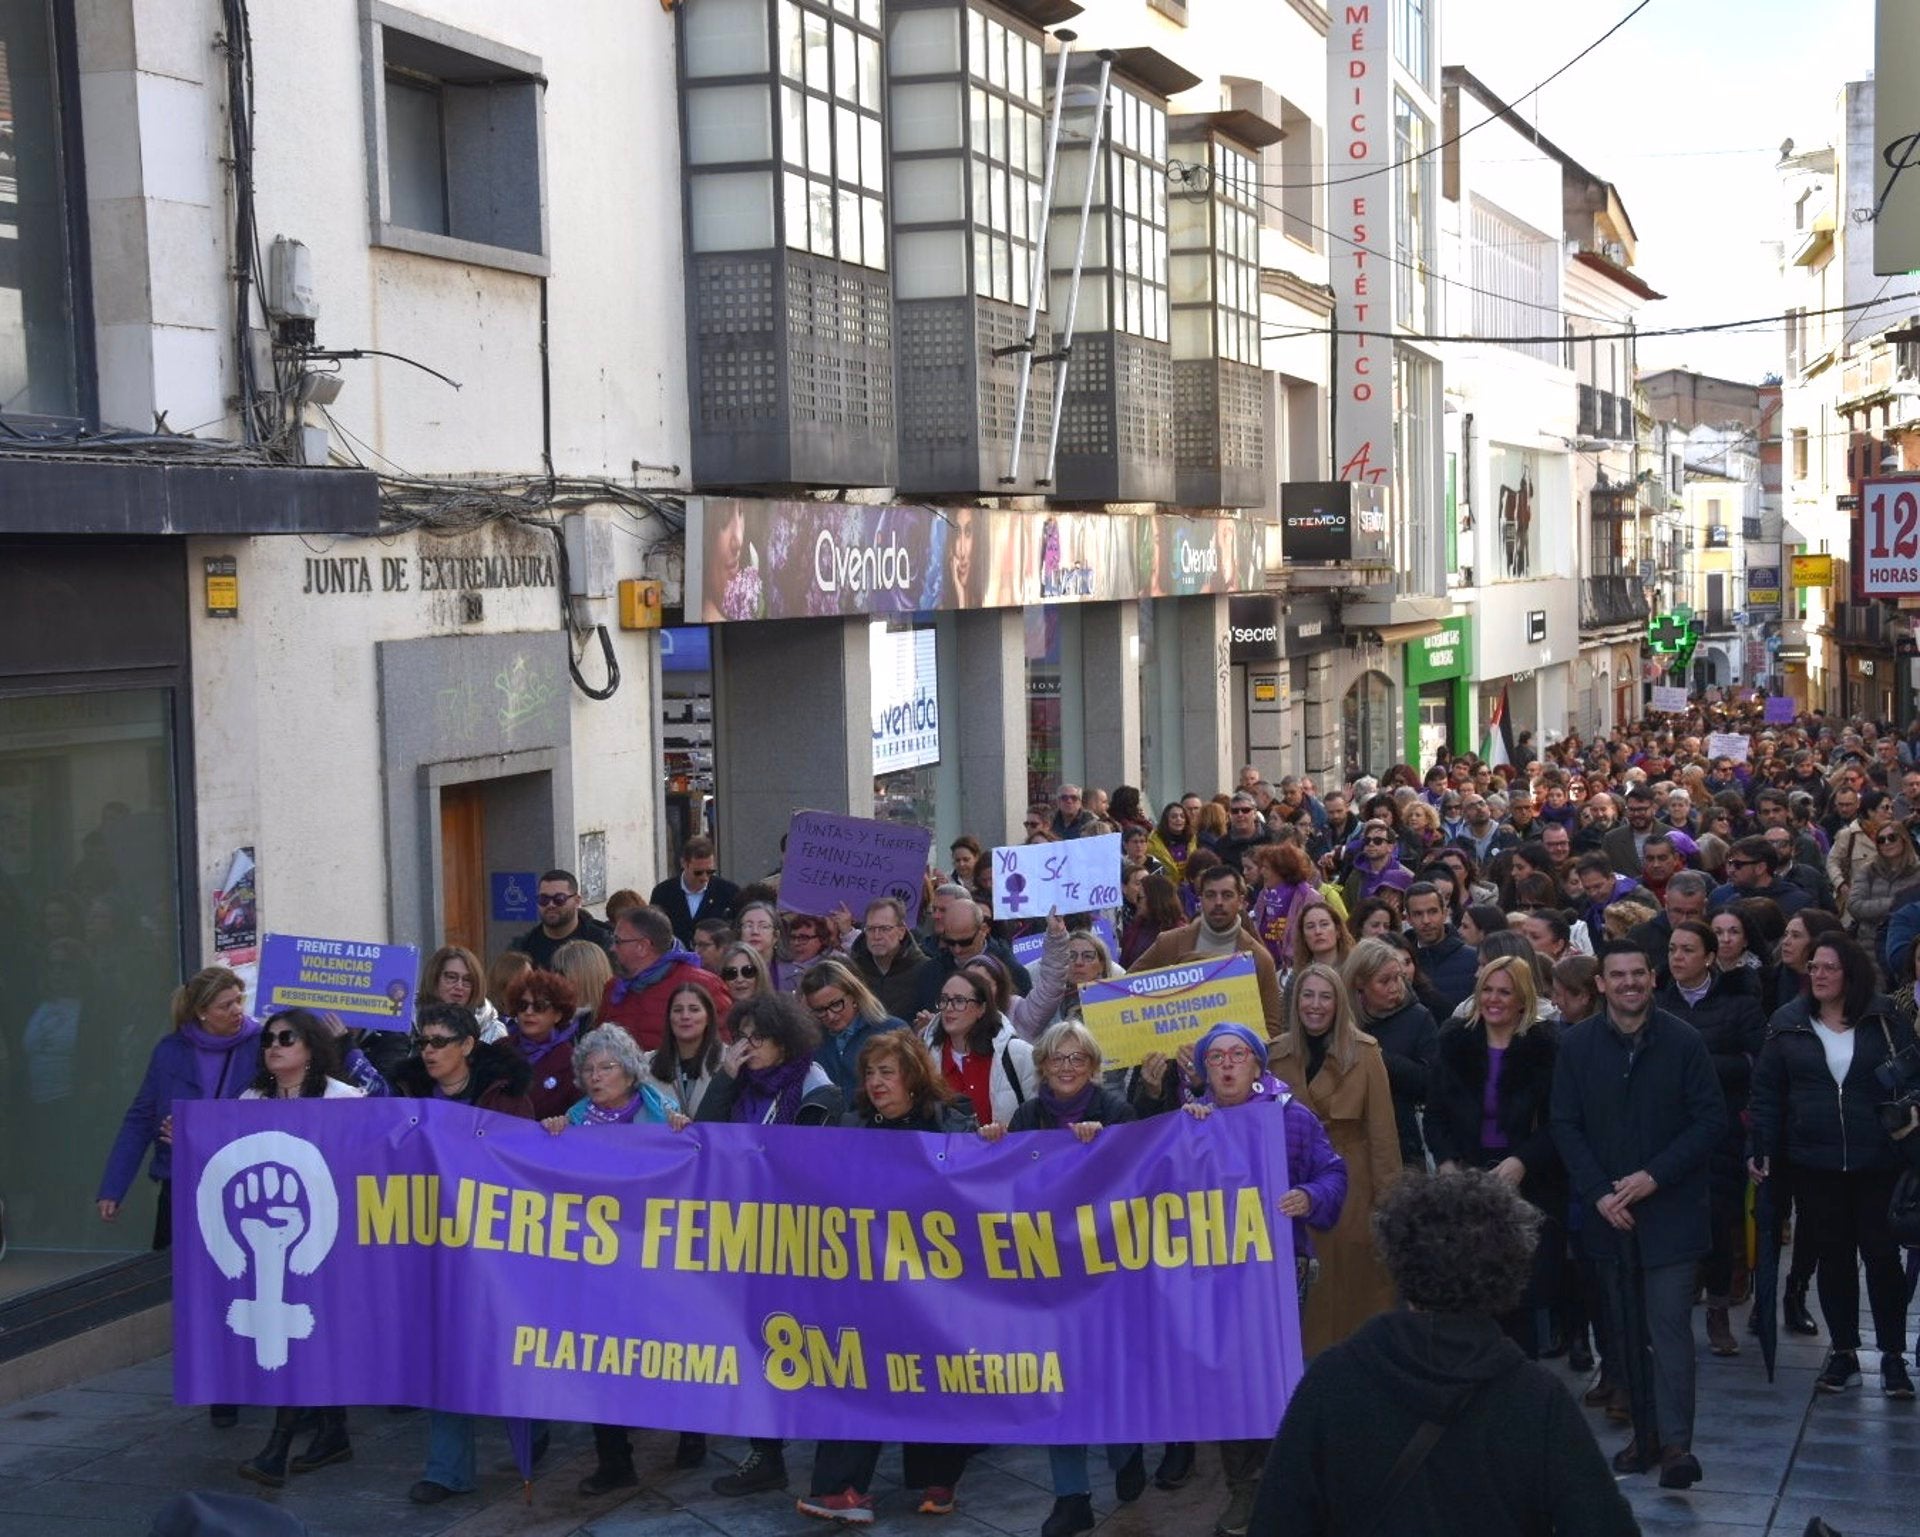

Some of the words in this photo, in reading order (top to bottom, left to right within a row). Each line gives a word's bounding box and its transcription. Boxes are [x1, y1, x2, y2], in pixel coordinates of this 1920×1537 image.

[1345, 5, 1369, 160] MÉDICO
[1352, 197, 1372, 402] ESTÉTICO
[1870, 491, 1918, 560] 12
[303, 557, 373, 594] JUNTA
[382, 558, 410, 592] DE
[420, 554, 556, 591] EXTREMADURA
[1869, 568, 1918, 583] HORAS
[801, 842, 894, 873] FEMINISTAS
[996, 850, 1018, 873] YO
[798, 867, 881, 894] SIEMPRE
[1061, 882, 1080, 900] TE
[1088, 885, 1118, 905] CREO
[296, 940, 342, 955] FRENTE
[346, 944, 356, 957] A
[357, 945, 380, 959] LAS
[302, 955, 373, 973] VIOLENCIAS
[299, 970, 371, 988] MACHISTAS
[1129, 967, 1206, 997] ¡CUIDADO!
[281, 990, 339, 1003] RESISTENCIA
[340, 995, 389, 1008] FEMINISTA
[1120, 1010, 1138, 1024] EL
[1141, 992, 1228, 1019] MACHISMO
[1153, 1015, 1199, 1035] MATA
[356, 1174, 620, 1266] MUJERES
[641, 1197, 963, 1281] FEMINISTAS
[977, 1211, 1061, 1279] EN
[1075, 1186, 1274, 1276] LUCHA
[512, 1326, 739, 1386] PLATAFORMA
[760, 1311, 868, 1391] 8M
[886, 1353, 927, 1392] DE
[935, 1347, 1064, 1394] MÉRIDA
